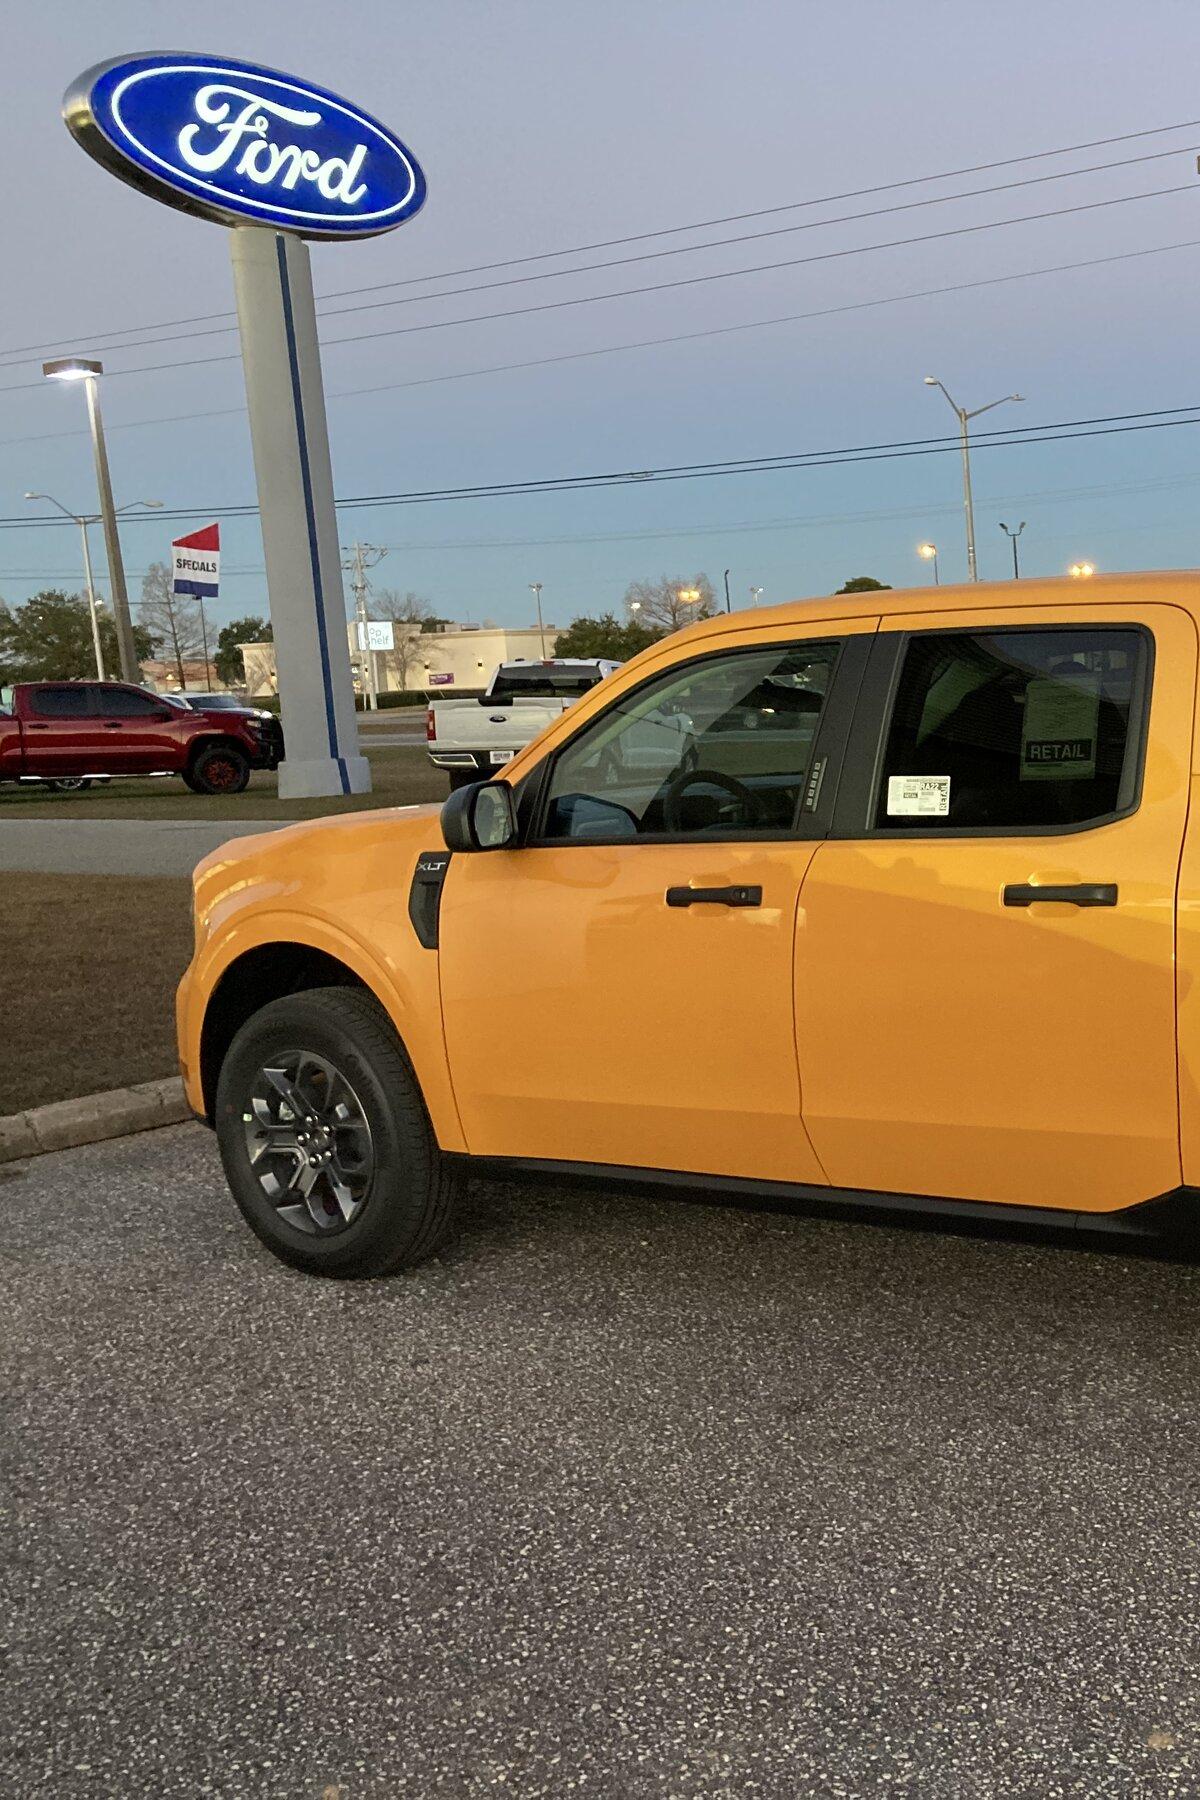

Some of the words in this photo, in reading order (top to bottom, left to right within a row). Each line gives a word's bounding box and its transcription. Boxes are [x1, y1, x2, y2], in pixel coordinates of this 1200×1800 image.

[178, 84, 368, 204] Ford
[176, 558, 217, 573] SPECIALS
[1030, 744, 1085, 760] RETAIL
[416, 861, 446, 871] XLT
